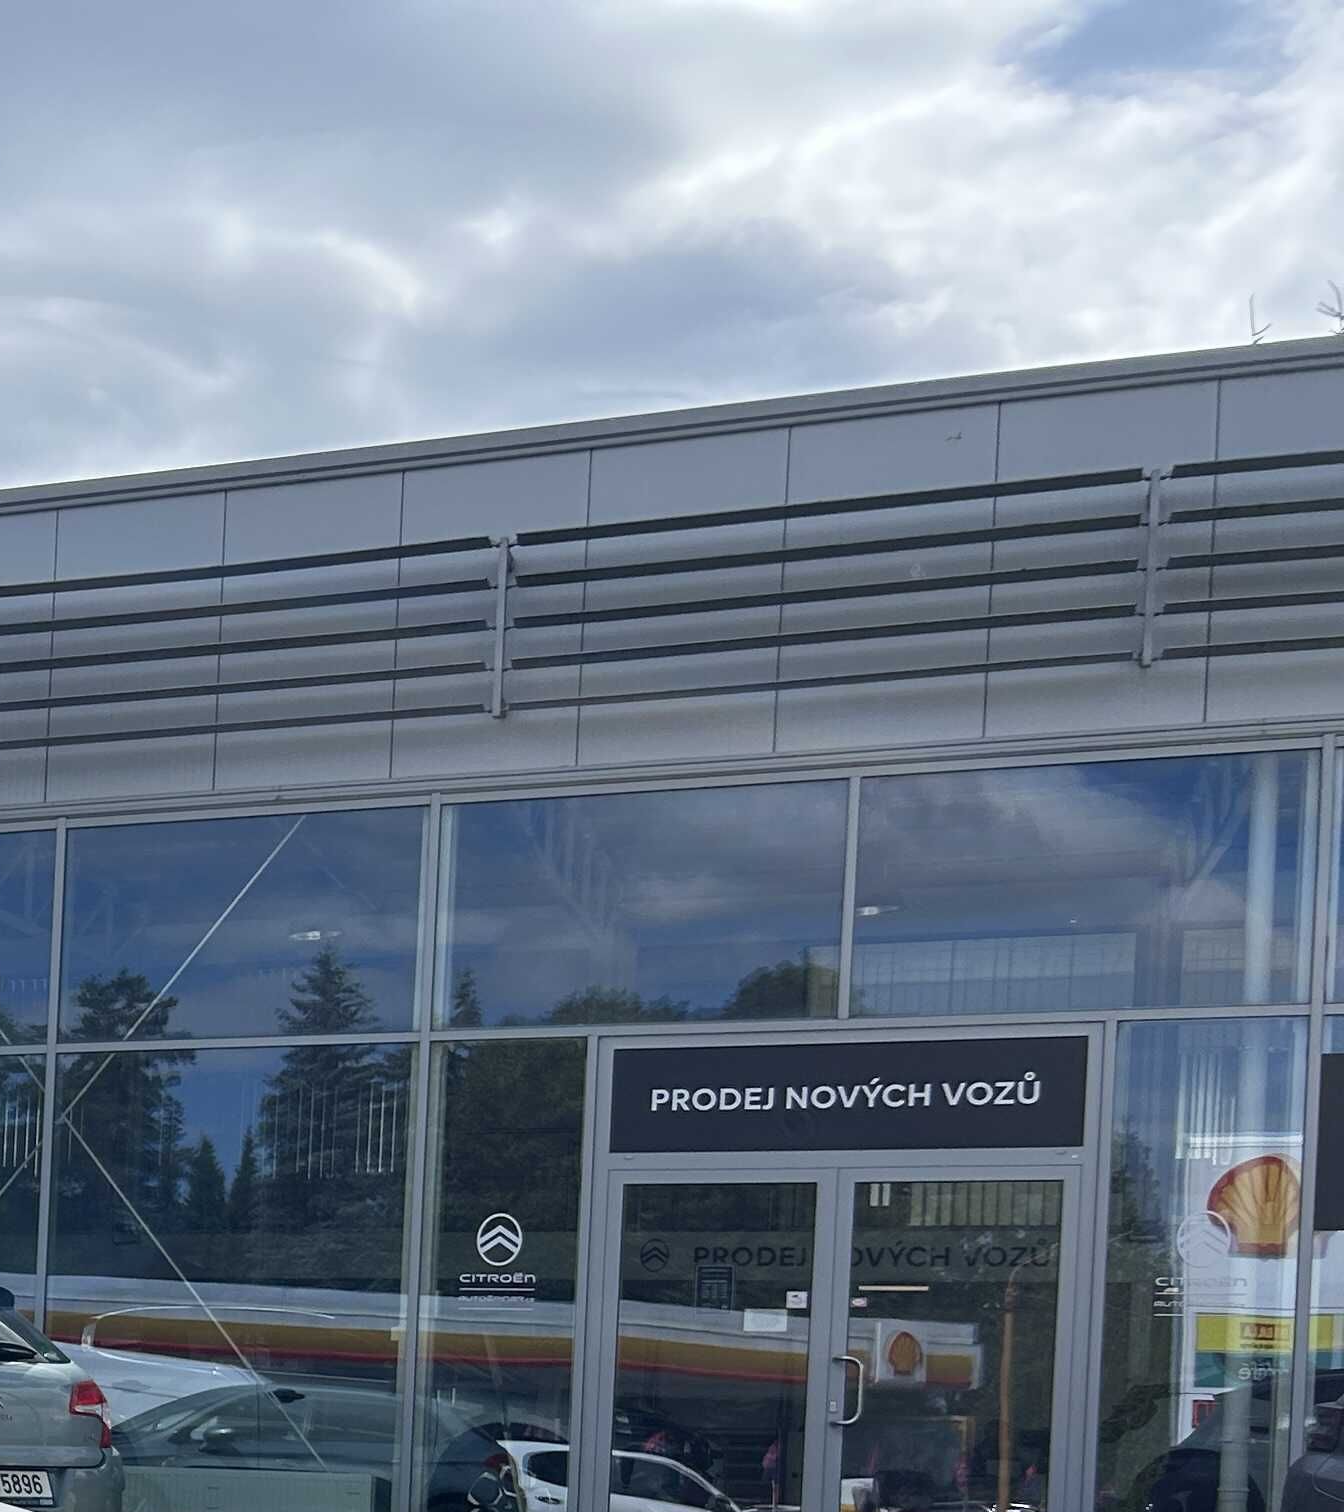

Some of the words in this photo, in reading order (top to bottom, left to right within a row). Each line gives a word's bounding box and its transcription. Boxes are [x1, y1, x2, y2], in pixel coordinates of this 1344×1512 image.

[649, 1086, 775, 1112] PRODEJ
[785, 1077, 932, 1110] NOVÝCH
[942, 1071, 1042, 1106] VOZŮ
[693, 1245, 807, 1268] PRODEJ
[851, 1239, 951, 1268] OVÝCH
[459, 1271, 537, 1284] CITROËN
[0, 1472, 44, 1495] 5896
